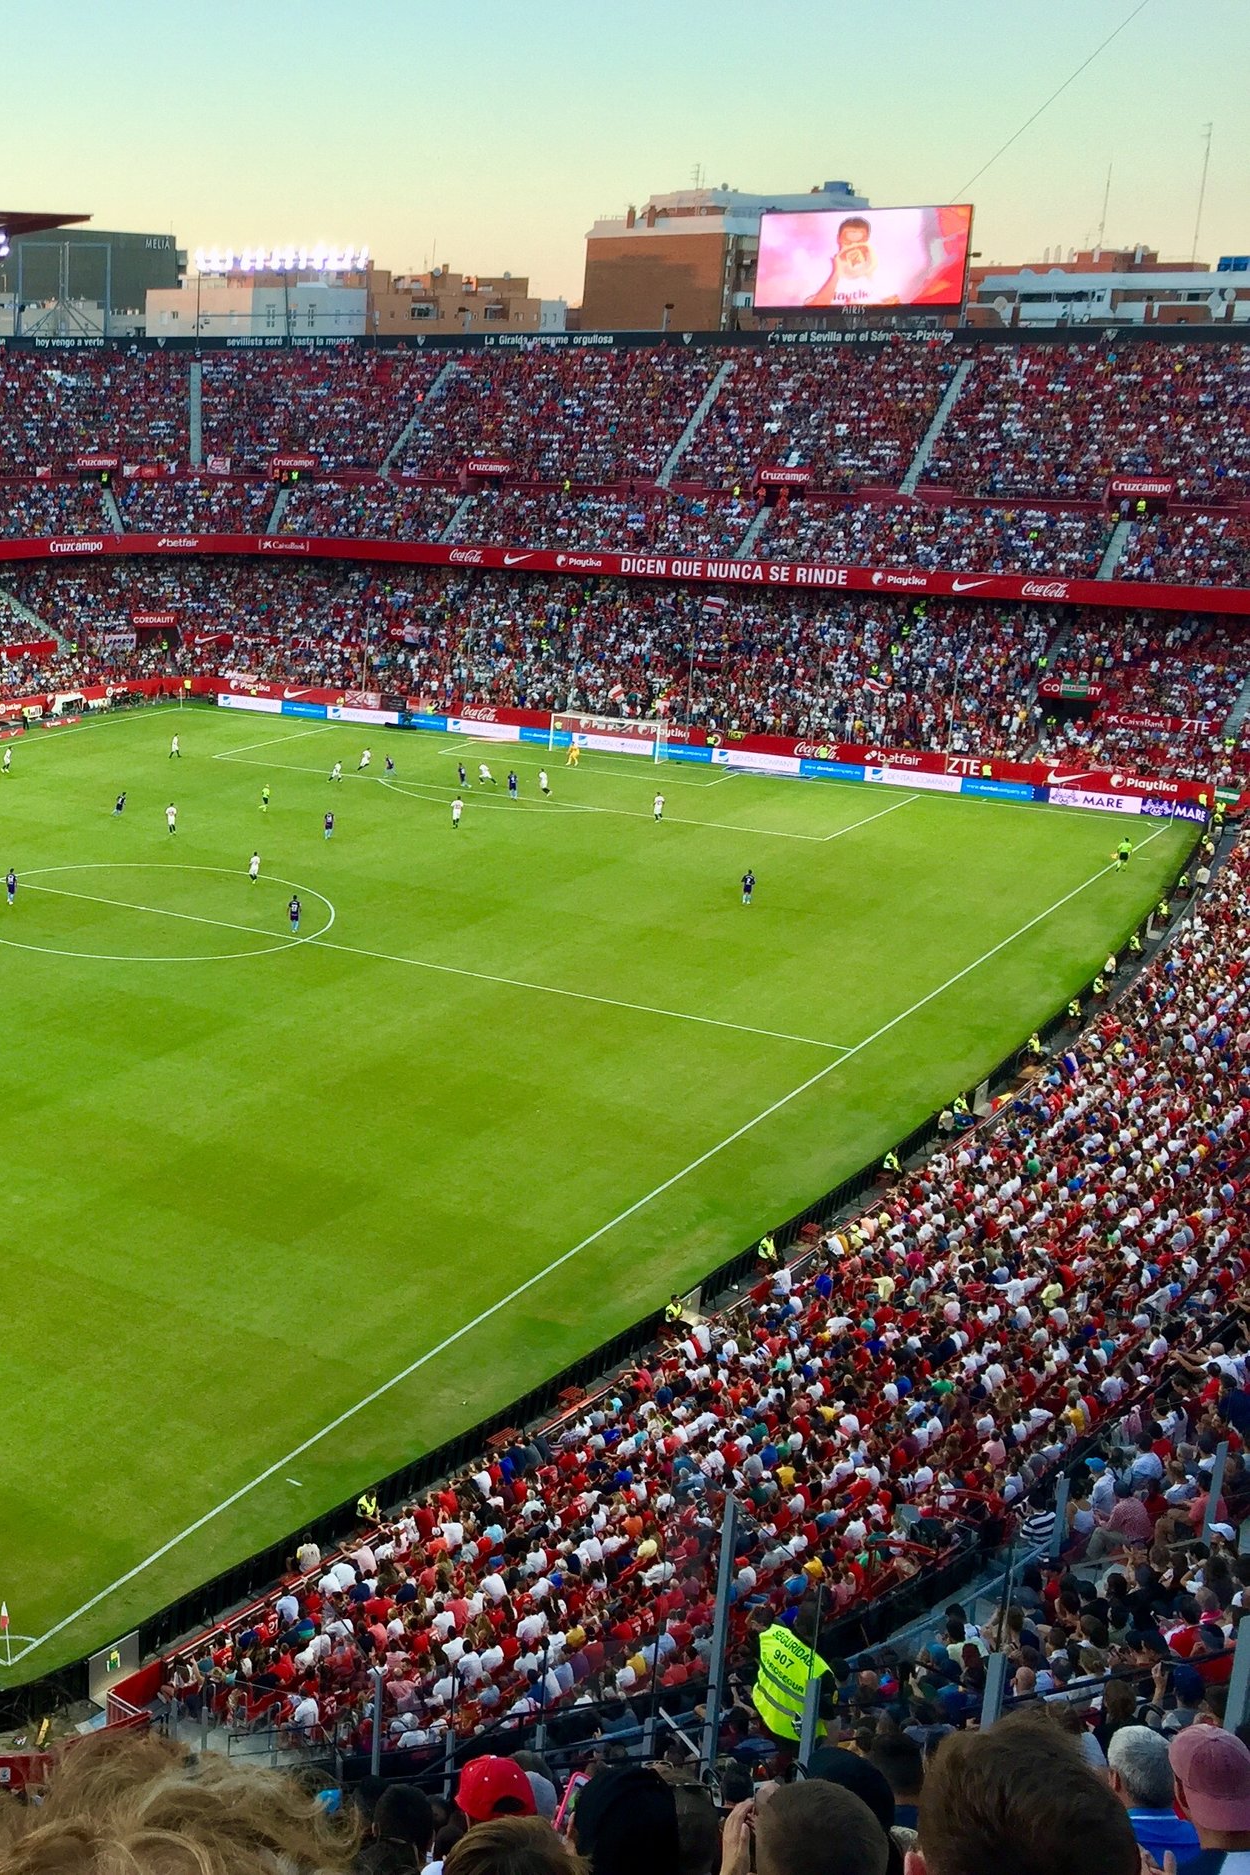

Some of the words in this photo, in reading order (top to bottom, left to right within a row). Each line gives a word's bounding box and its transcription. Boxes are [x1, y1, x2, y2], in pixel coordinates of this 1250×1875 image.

[226, 336, 263, 346] sevillista
[265, 336, 283, 346] seré
[292, 336, 315, 346] hasta
[316, 336, 324, 346] la
[484, 335, 495, 346] La
[499, 334, 529, 346] Giralda
[572, 334, 614, 346] orgullosa
[782, 333, 798, 342] ver
[799, 331, 808, 342] al
[810, 330, 842, 342] Sevilla
[844, 332, 858, 342] en
[859, 330, 869, 342] el
[35, 337, 51, 348] hoy
[52, 338, 75, 348] vengo
[77, 338, 83, 346] a
[84, 337, 104, 346] verte
[77, 457, 118, 468] Cruzcampo
[273, 457, 315, 468] Cruzcampo
[468, 461, 510, 473] Cruzcampo
[761, 470, 810, 482] Cruzcampo
[1112, 480, 1171, 494] Cruzcampo
[50, 541, 103, 553] Cruzcampo
[166, 537, 199, 549] betfair
[272, 540, 306, 551] CaixaBank
[568, 556, 603, 569] Playtika
[621, 557, 667, 575] DICEN
[671, 560, 703, 578] QUE
[706, 561, 763, 581] NUNCA
[769, 565, 790, 582] SE
[796, 567, 848, 586] RINDE
[886, 575, 927, 587] Playtika
[133, 616, 175, 625] CORDIALITY
[298, 639, 317, 650] ZTE
[1043, 682, 1102, 697] COITY
[1119, 714, 1165, 730] CaixaBank
[1180, 718, 1212, 736] ZTE
[732, 753, 758, 764] DENTAL
[759, 756, 795, 768] COMPANY
[877, 750, 922, 766] betfair
[947, 757, 982, 776] ZTE
[886, 772, 913, 783] DENTAL
[913, 774, 956, 789] COMPANY
[1126, 776, 1179, 793] Playtika
[1082, 796, 1124, 810] MARE
[1174, 804, 1207, 821] MARE
[771, 1630, 814, 1668] SEGURIDAD
[773, 1649, 795, 1670] 907
